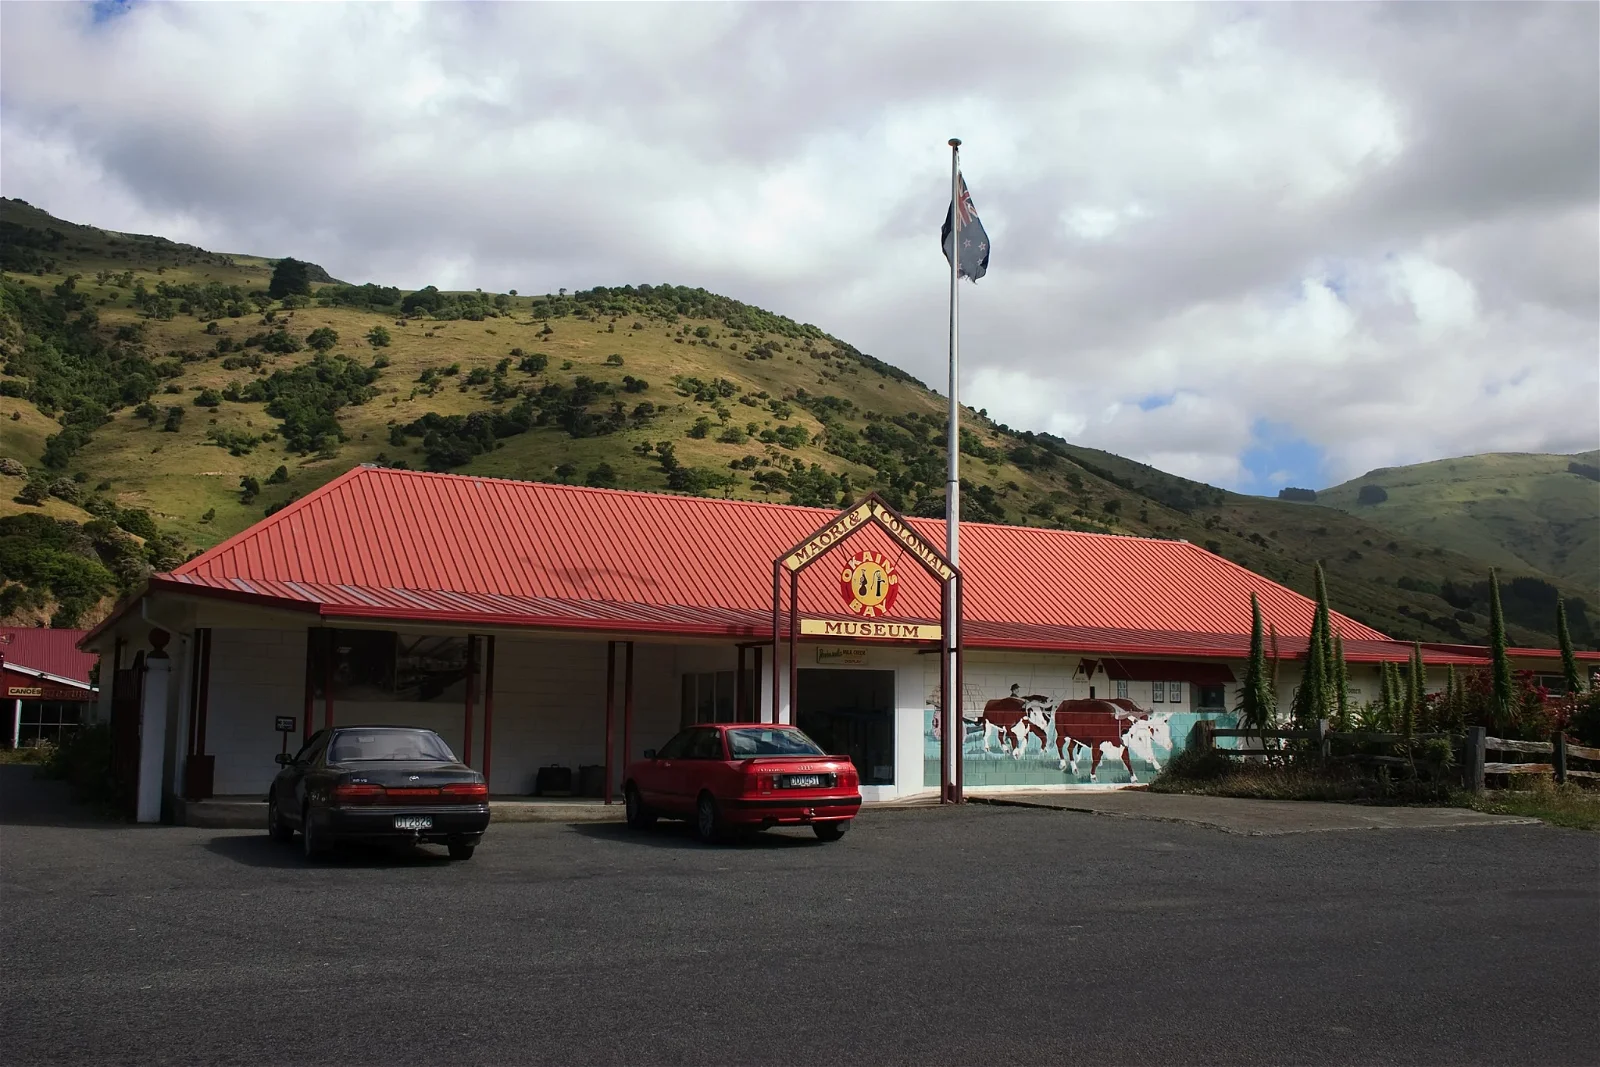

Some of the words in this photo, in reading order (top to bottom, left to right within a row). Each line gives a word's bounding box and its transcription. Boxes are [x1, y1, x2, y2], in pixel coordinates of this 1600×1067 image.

[795, 521, 851, 565] MAORI
[849, 510, 862, 525] &
[880, 510, 946, 576] COLONIAL
[842, 551, 898, 585] OKAINS
[849, 599, 887, 618] BAY
[824, 621, 919, 638] MUSEUM
